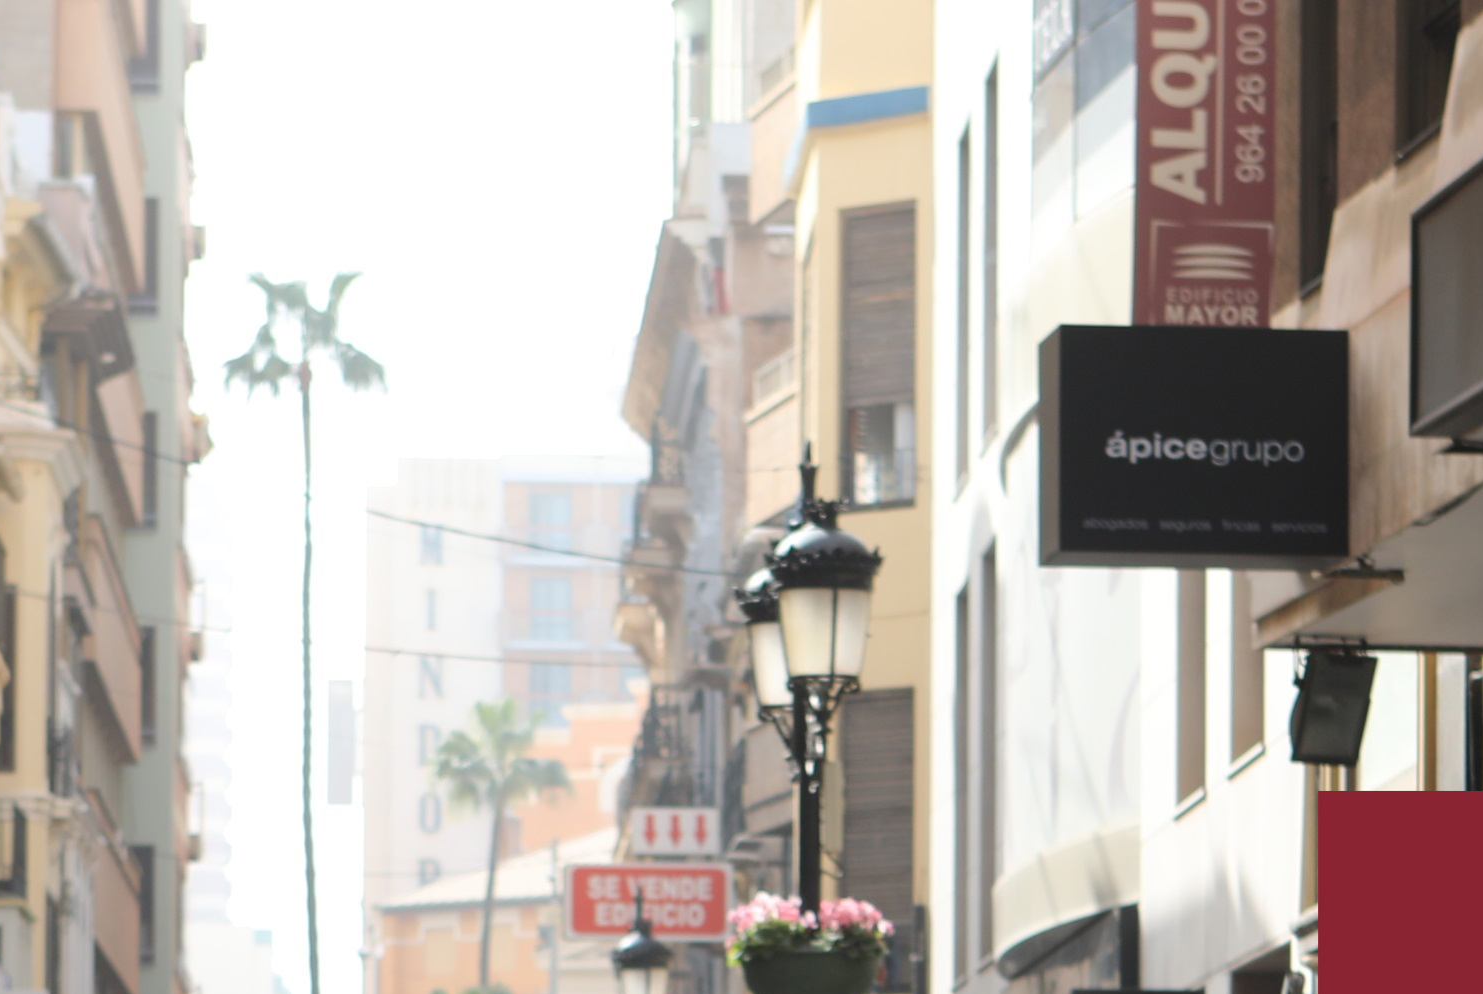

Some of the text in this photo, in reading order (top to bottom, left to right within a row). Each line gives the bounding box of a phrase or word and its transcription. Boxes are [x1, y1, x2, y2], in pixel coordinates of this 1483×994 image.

[1236, 24, 1268, 66] 00
[1234, 74, 1267, 115] 26
[1234, 124, 1266, 184] 964
[1166, 285, 1260, 305] EDIFICIO
[1164, 304, 1260, 326] MAYOR
[586, 873, 714, 903] SE VENDE
